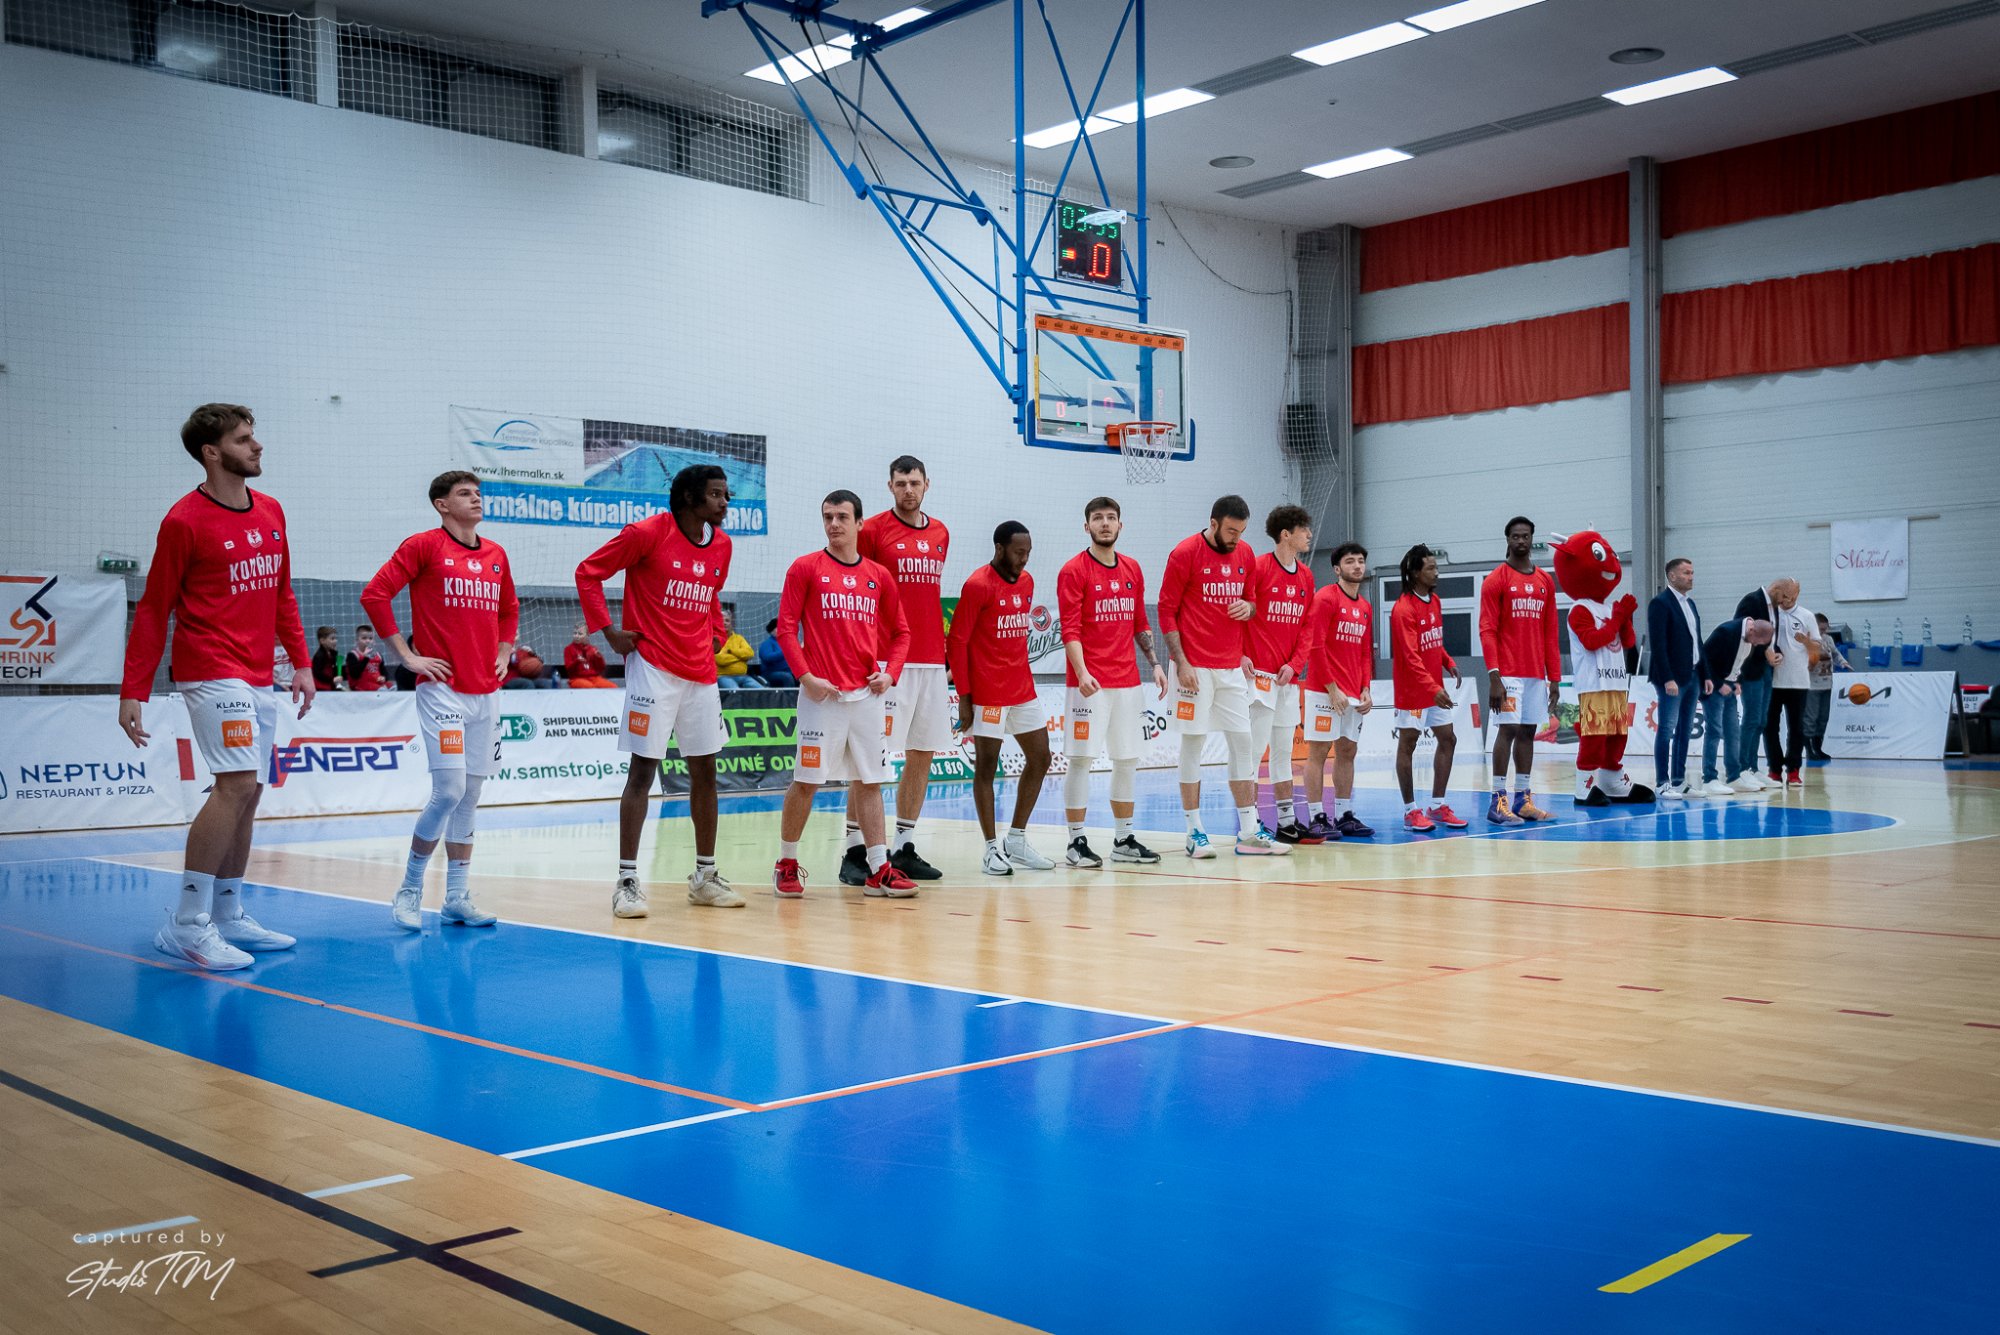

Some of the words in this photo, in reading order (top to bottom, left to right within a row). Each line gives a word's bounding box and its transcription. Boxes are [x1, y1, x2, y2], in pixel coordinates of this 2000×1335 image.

[821, 592, 876, 614] KOMÁRNO
[0, 666, 42, 679] ECH
[543, 715, 618, 726] SHIPBUILDING
[545, 729, 568, 738] AND
[662, 753, 766, 774] PROVNÉ
[945, 760, 964, 777] 819
[20, 762, 146, 783] NEPTUN
[16, 787, 102, 799] RESTAURANT
[106, 787, 114, 795] &
[118, 785, 155, 795] PIZZA
